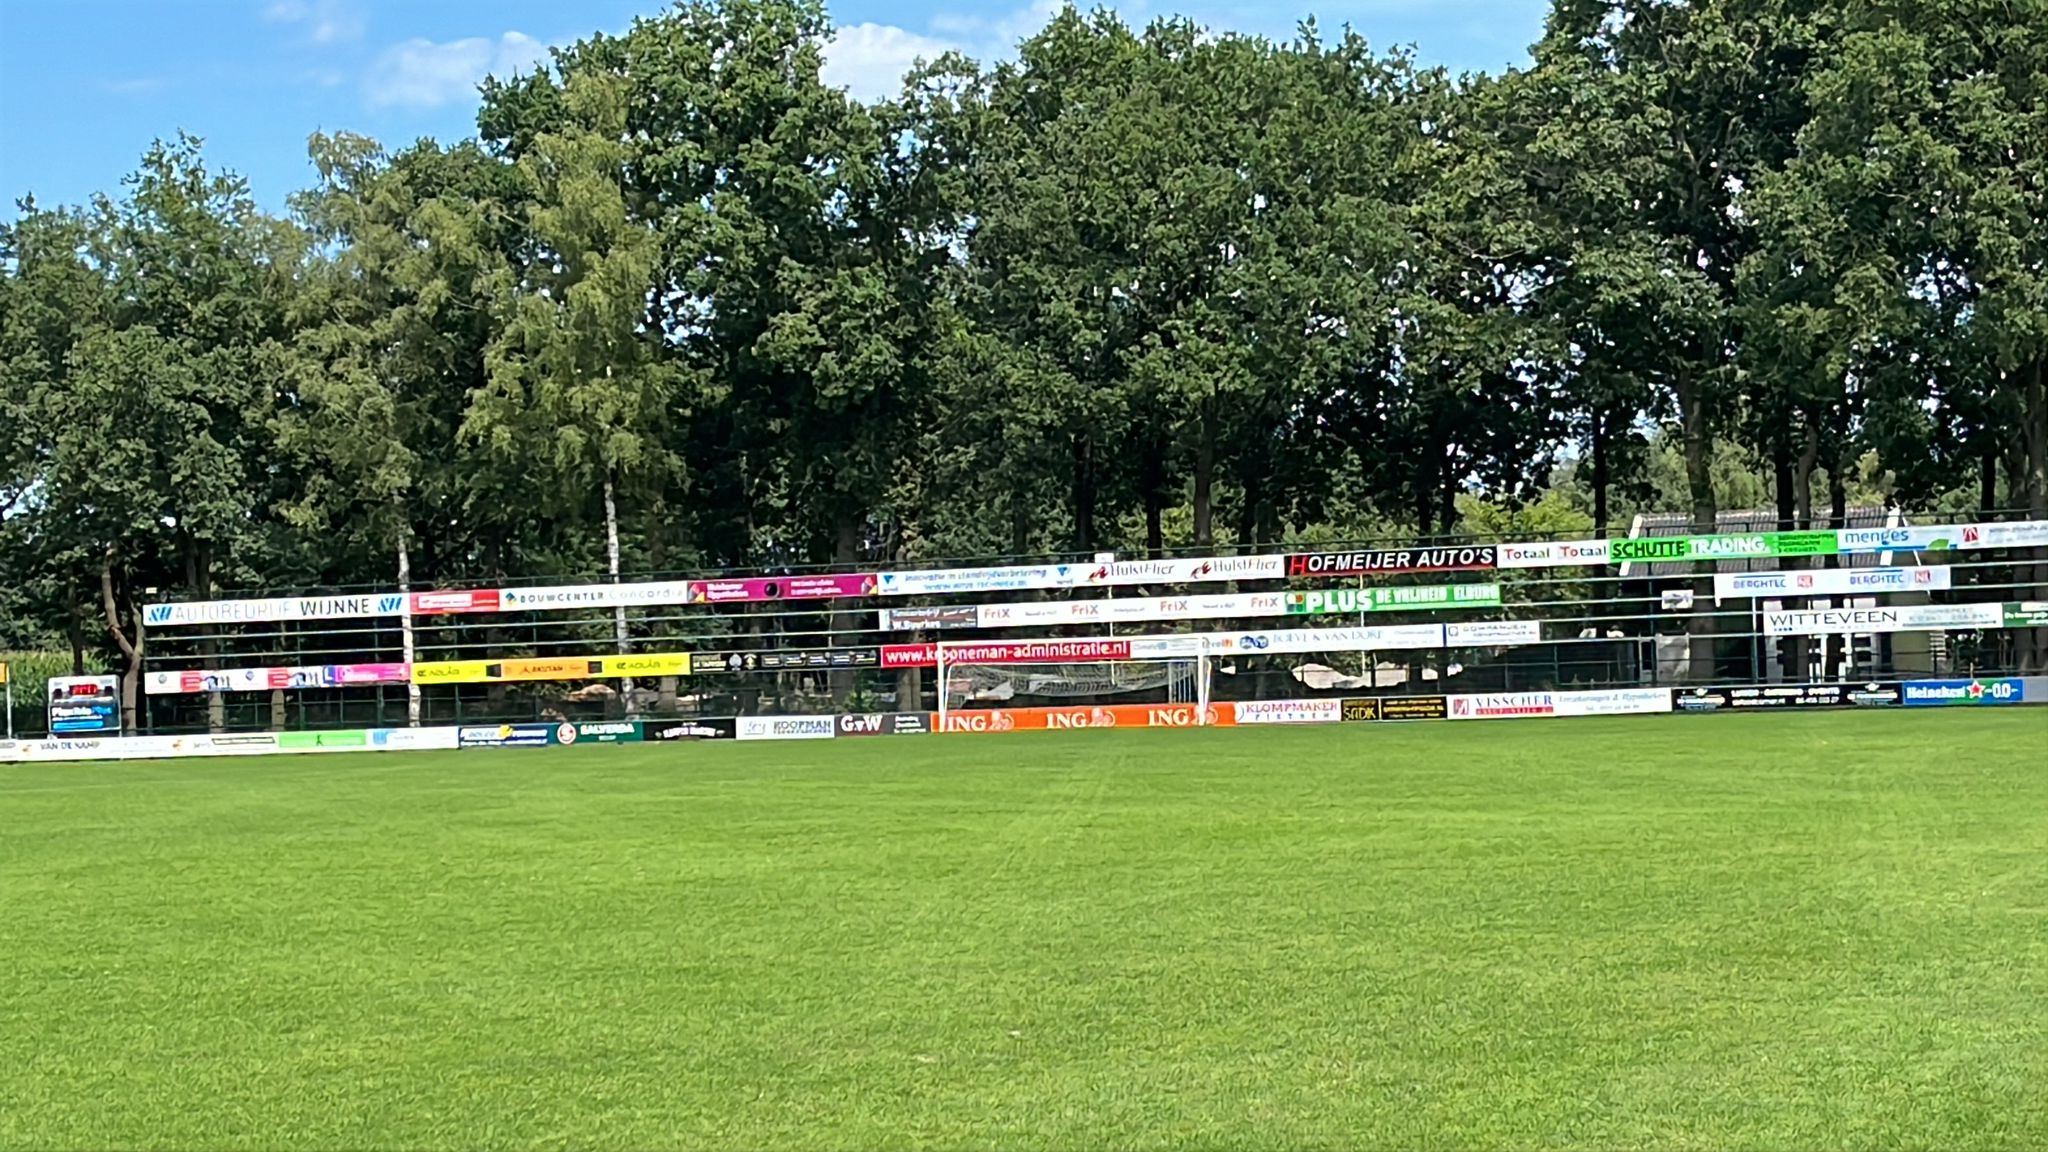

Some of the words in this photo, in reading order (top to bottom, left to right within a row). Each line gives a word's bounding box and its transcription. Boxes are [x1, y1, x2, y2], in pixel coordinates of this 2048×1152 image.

[1845, 526, 1910, 546] menges
[1612, 540, 1685, 559] SCHUTTE
[1290, 550, 1410, 576] HOFMEIJER
[1416, 548, 1494, 568] AUTO'S
[520, 591, 604, 604] BOUWCENTER
[1305, 588, 1374, 612] PLUS
[175, 601, 292, 621] AUTOBEDRIJF
[300, 598, 371, 616] WIJNNE
[1769, 610, 1897, 627] WITTEVEEN
[1906, 686, 1966, 699] Heineken
[1246, 702, 1338, 715] KLOMPMAKER
[1475, 695, 1553, 708] VISSCHER
[947, 715, 987, 732] ING
[1046, 712, 1087, 729] ING
[1148, 709, 1189, 726] ING
